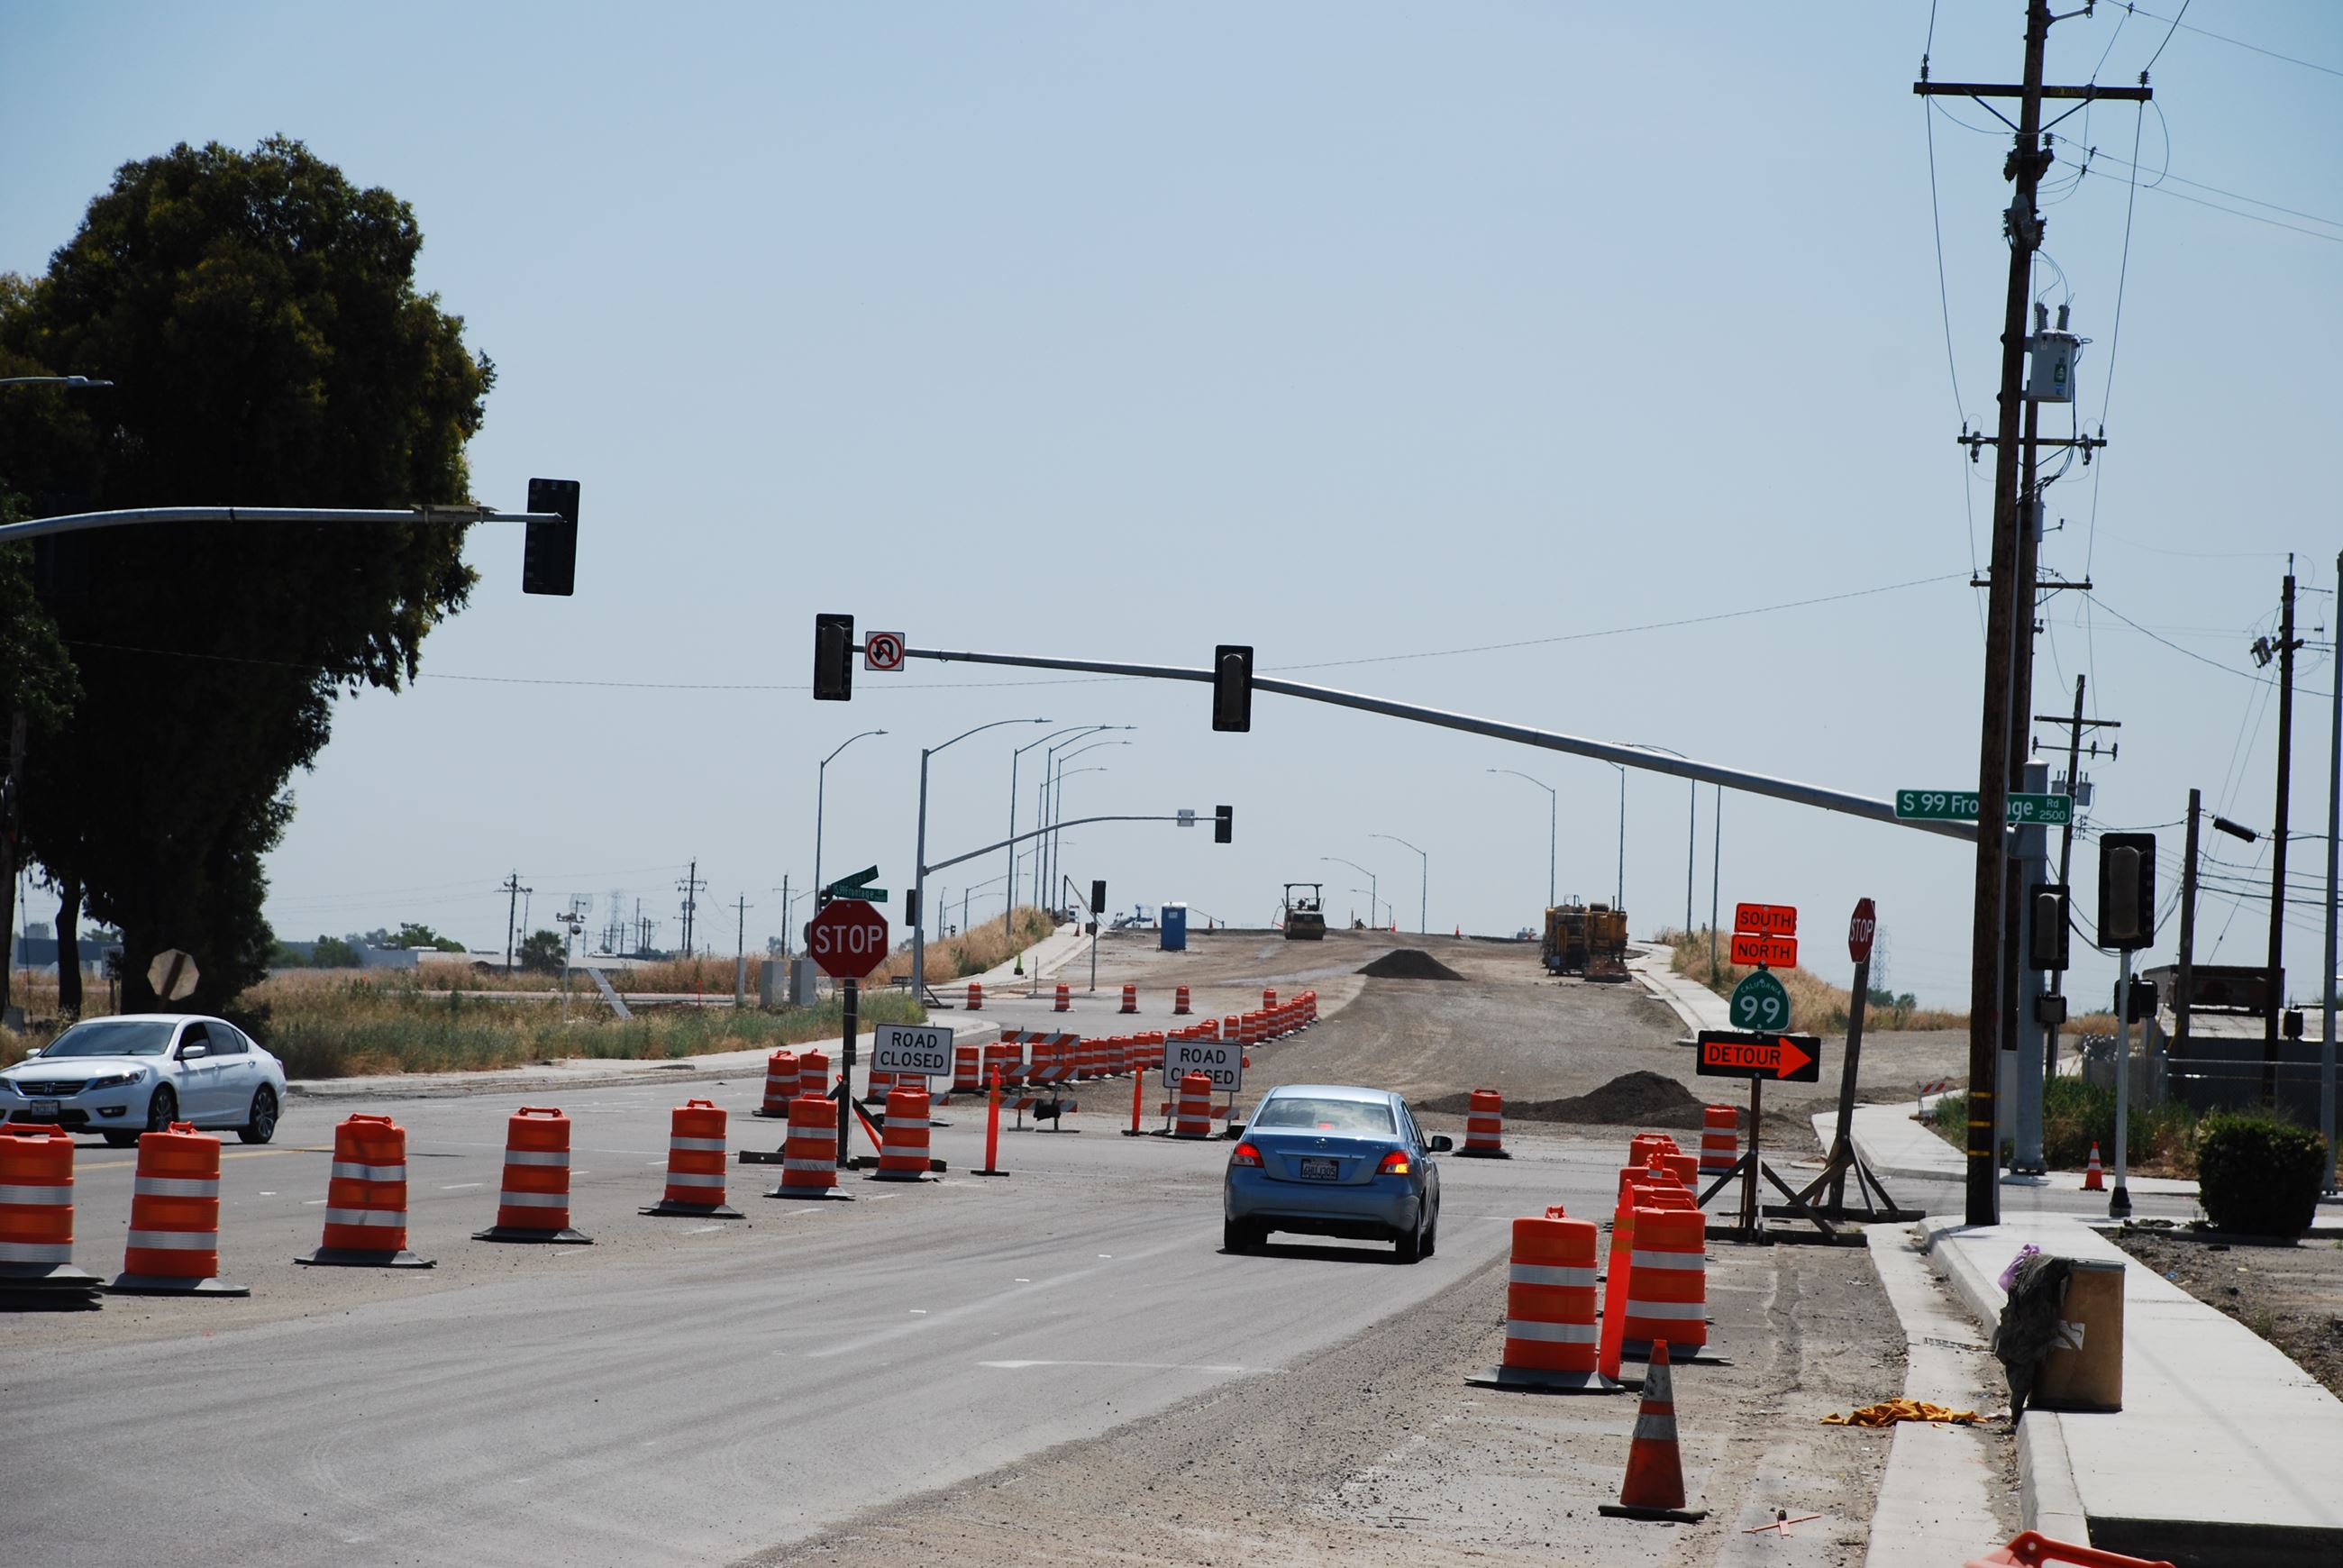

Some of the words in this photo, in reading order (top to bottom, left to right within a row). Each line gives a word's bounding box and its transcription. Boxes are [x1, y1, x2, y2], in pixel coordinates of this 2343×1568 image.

[1903, 793, 1915, 811] S
[1921, 794, 1946, 812] 99
[1951, 795, 2034, 821] Froge
[2047, 798, 2059, 809] Rd
[2039, 810, 2065, 821] 2500
[1740, 911, 1791, 928] SOUTH
[1850, 917, 1873, 943] STOP
[816, 925, 883, 953] STOP
[1737, 944, 1790, 960] NORTH
[1740, 995, 1781, 1024] 99
[891, 1032, 937, 1049] ROAD
[880, 1051, 944, 1069] CLOSED
[1181, 1047, 1226, 1064] ROAD
[1709, 1045, 1782, 1066] DETOUR
